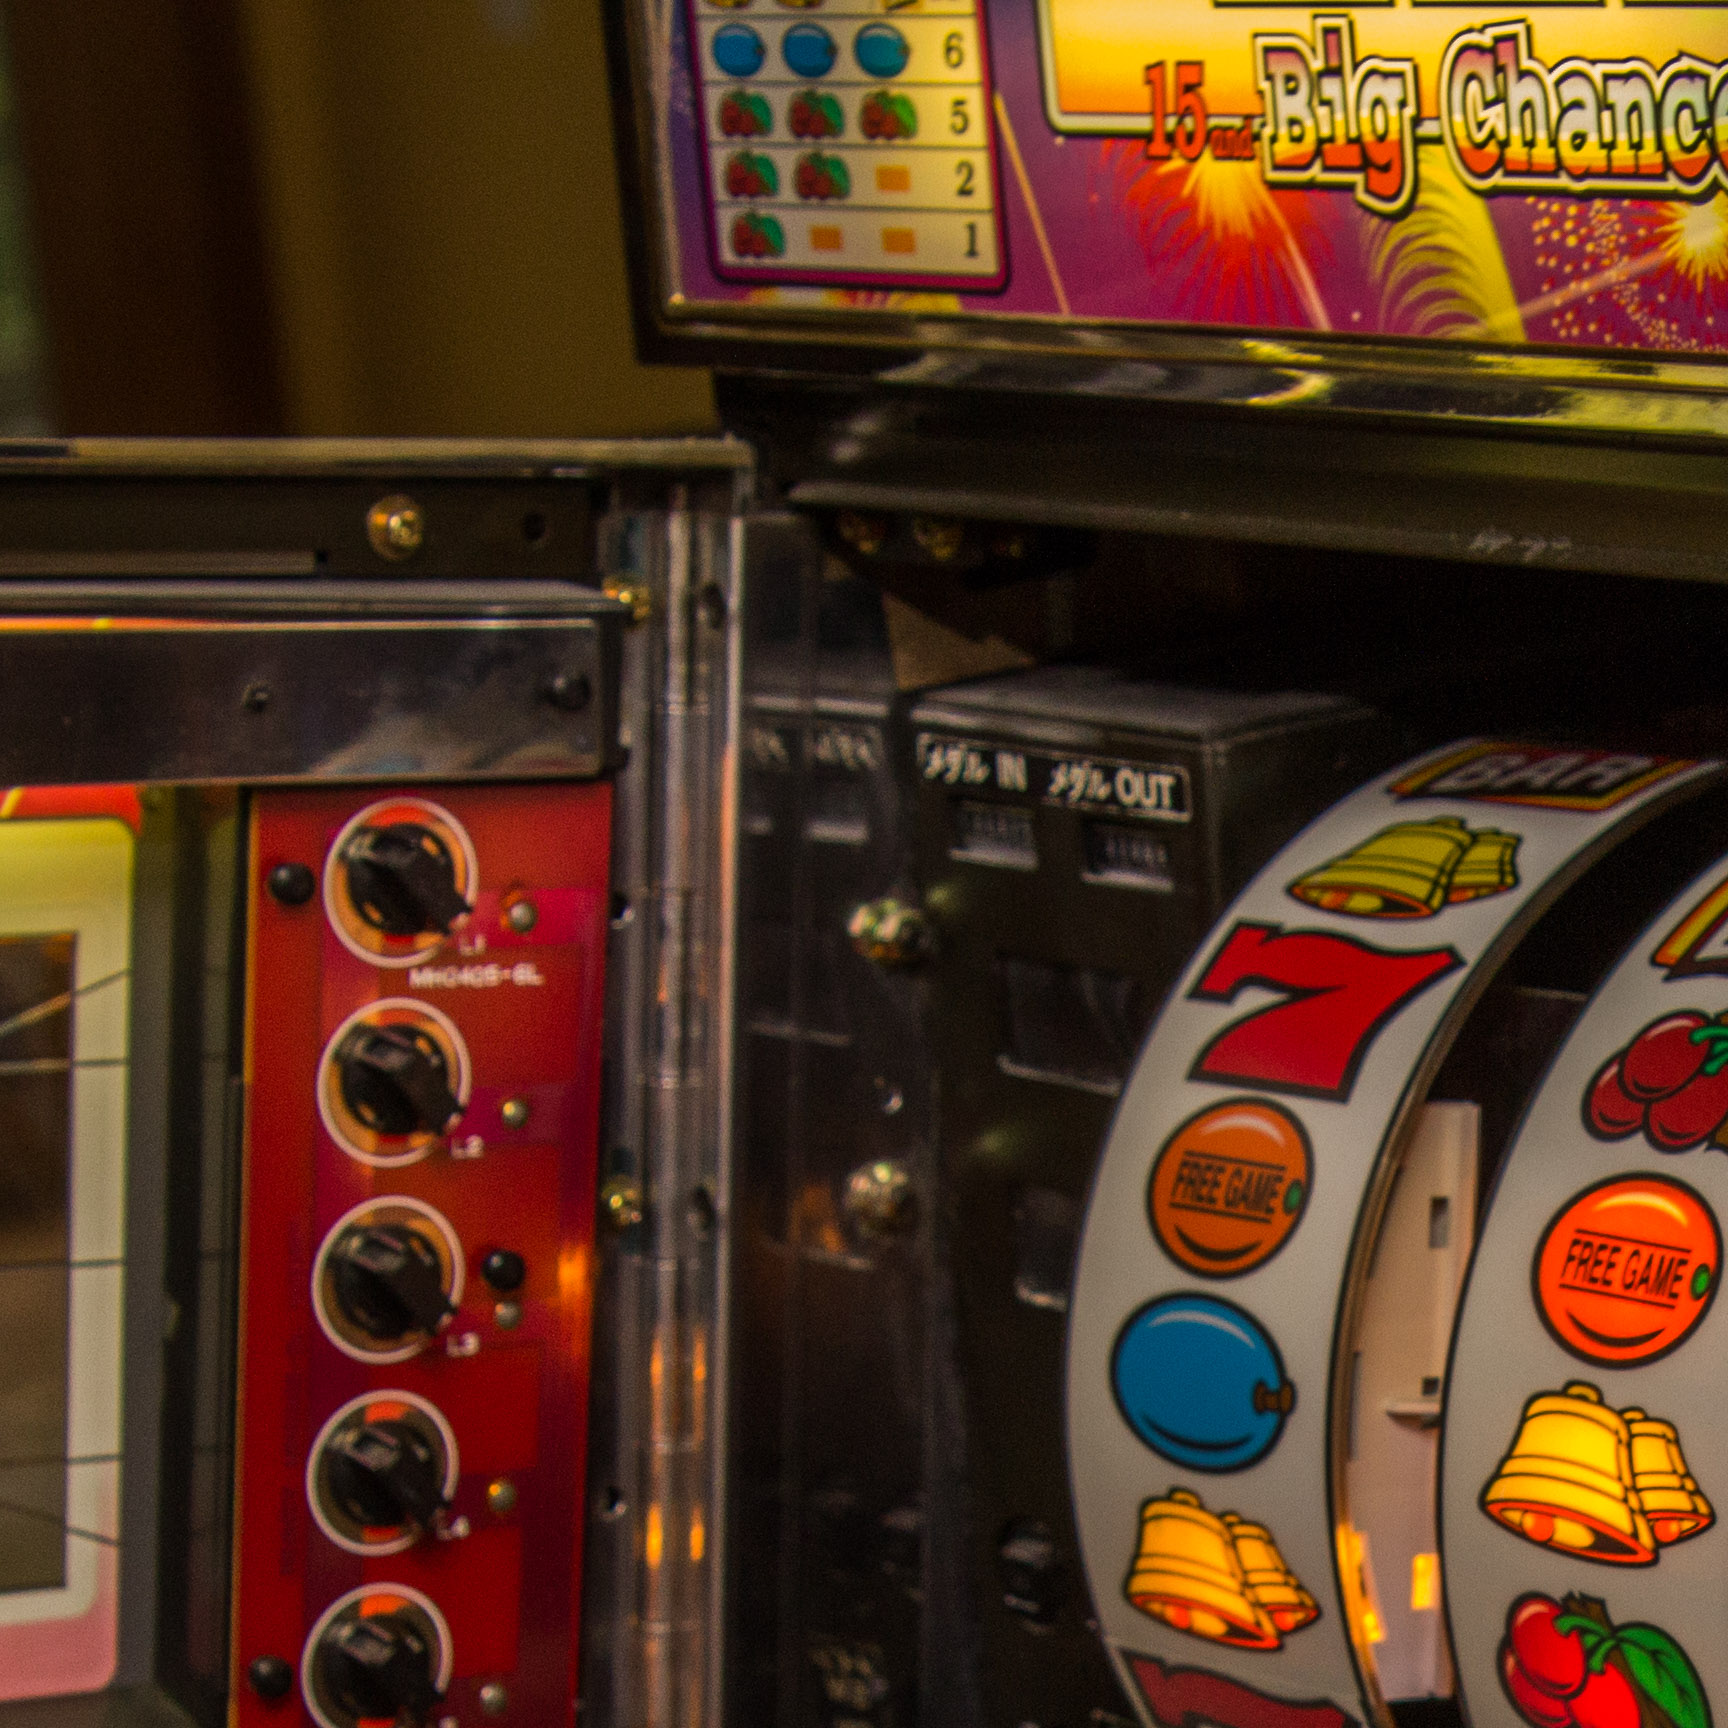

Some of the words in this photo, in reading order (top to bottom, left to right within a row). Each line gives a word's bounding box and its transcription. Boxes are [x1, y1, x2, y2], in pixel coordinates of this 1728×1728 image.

[944, 32, 964, 69] 6
[950, 99, 969, 134] 5
[1144, 60, 1207, 161] 15
[1254, 14, 1417, 220] Big
[955, 160, 975, 197] 2
[965, 221, 979, 258] 1
[995, 750, 1028, 793] IN
[1114, 766, 1176, 810] OUT
[1170, 1160, 1226, 1205] FREE
[1224, 1166, 1285, 1215] GAME
[1560, 1238, 1622, 1287] FREE
[1622, 1248, 1689, 1300] GAME
